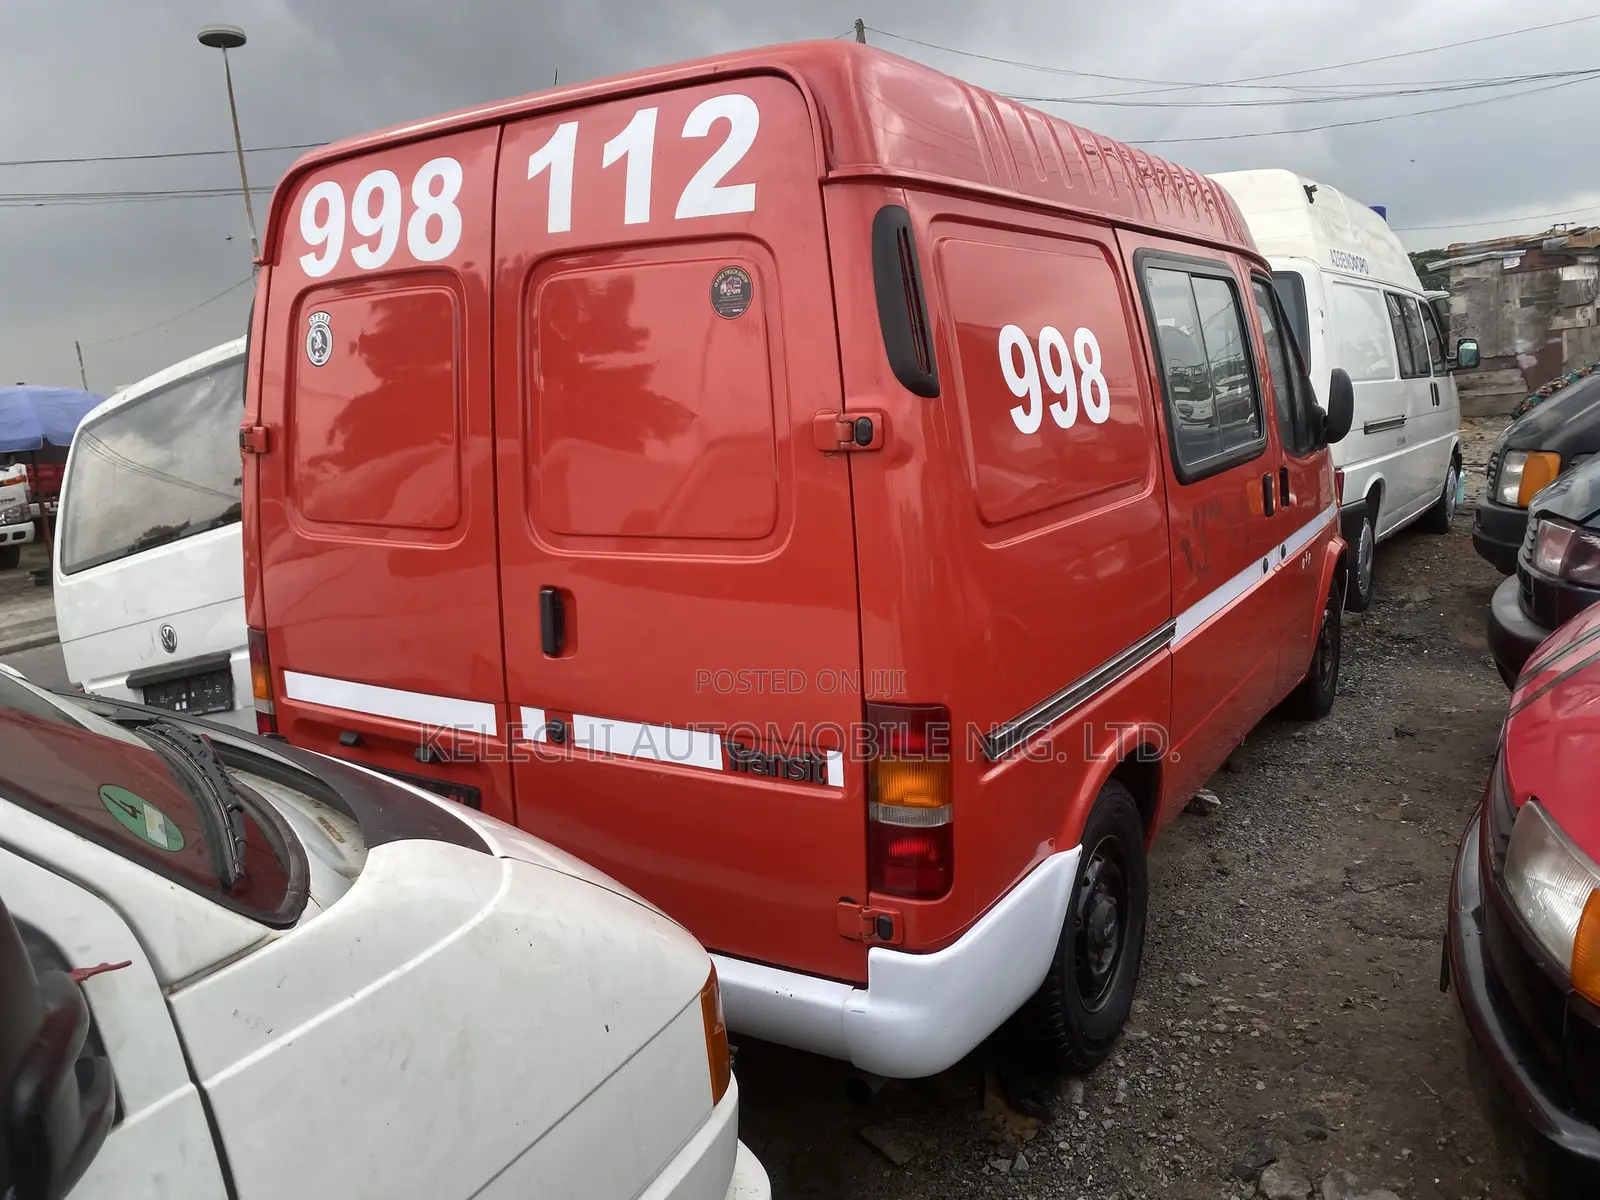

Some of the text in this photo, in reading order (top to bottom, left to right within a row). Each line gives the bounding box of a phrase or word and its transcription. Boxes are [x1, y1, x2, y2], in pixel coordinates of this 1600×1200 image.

[299, 93, 760, 278] 998 112
[998, 323, 1111, 435] 998
[721, 741, 827, 786] Transit
